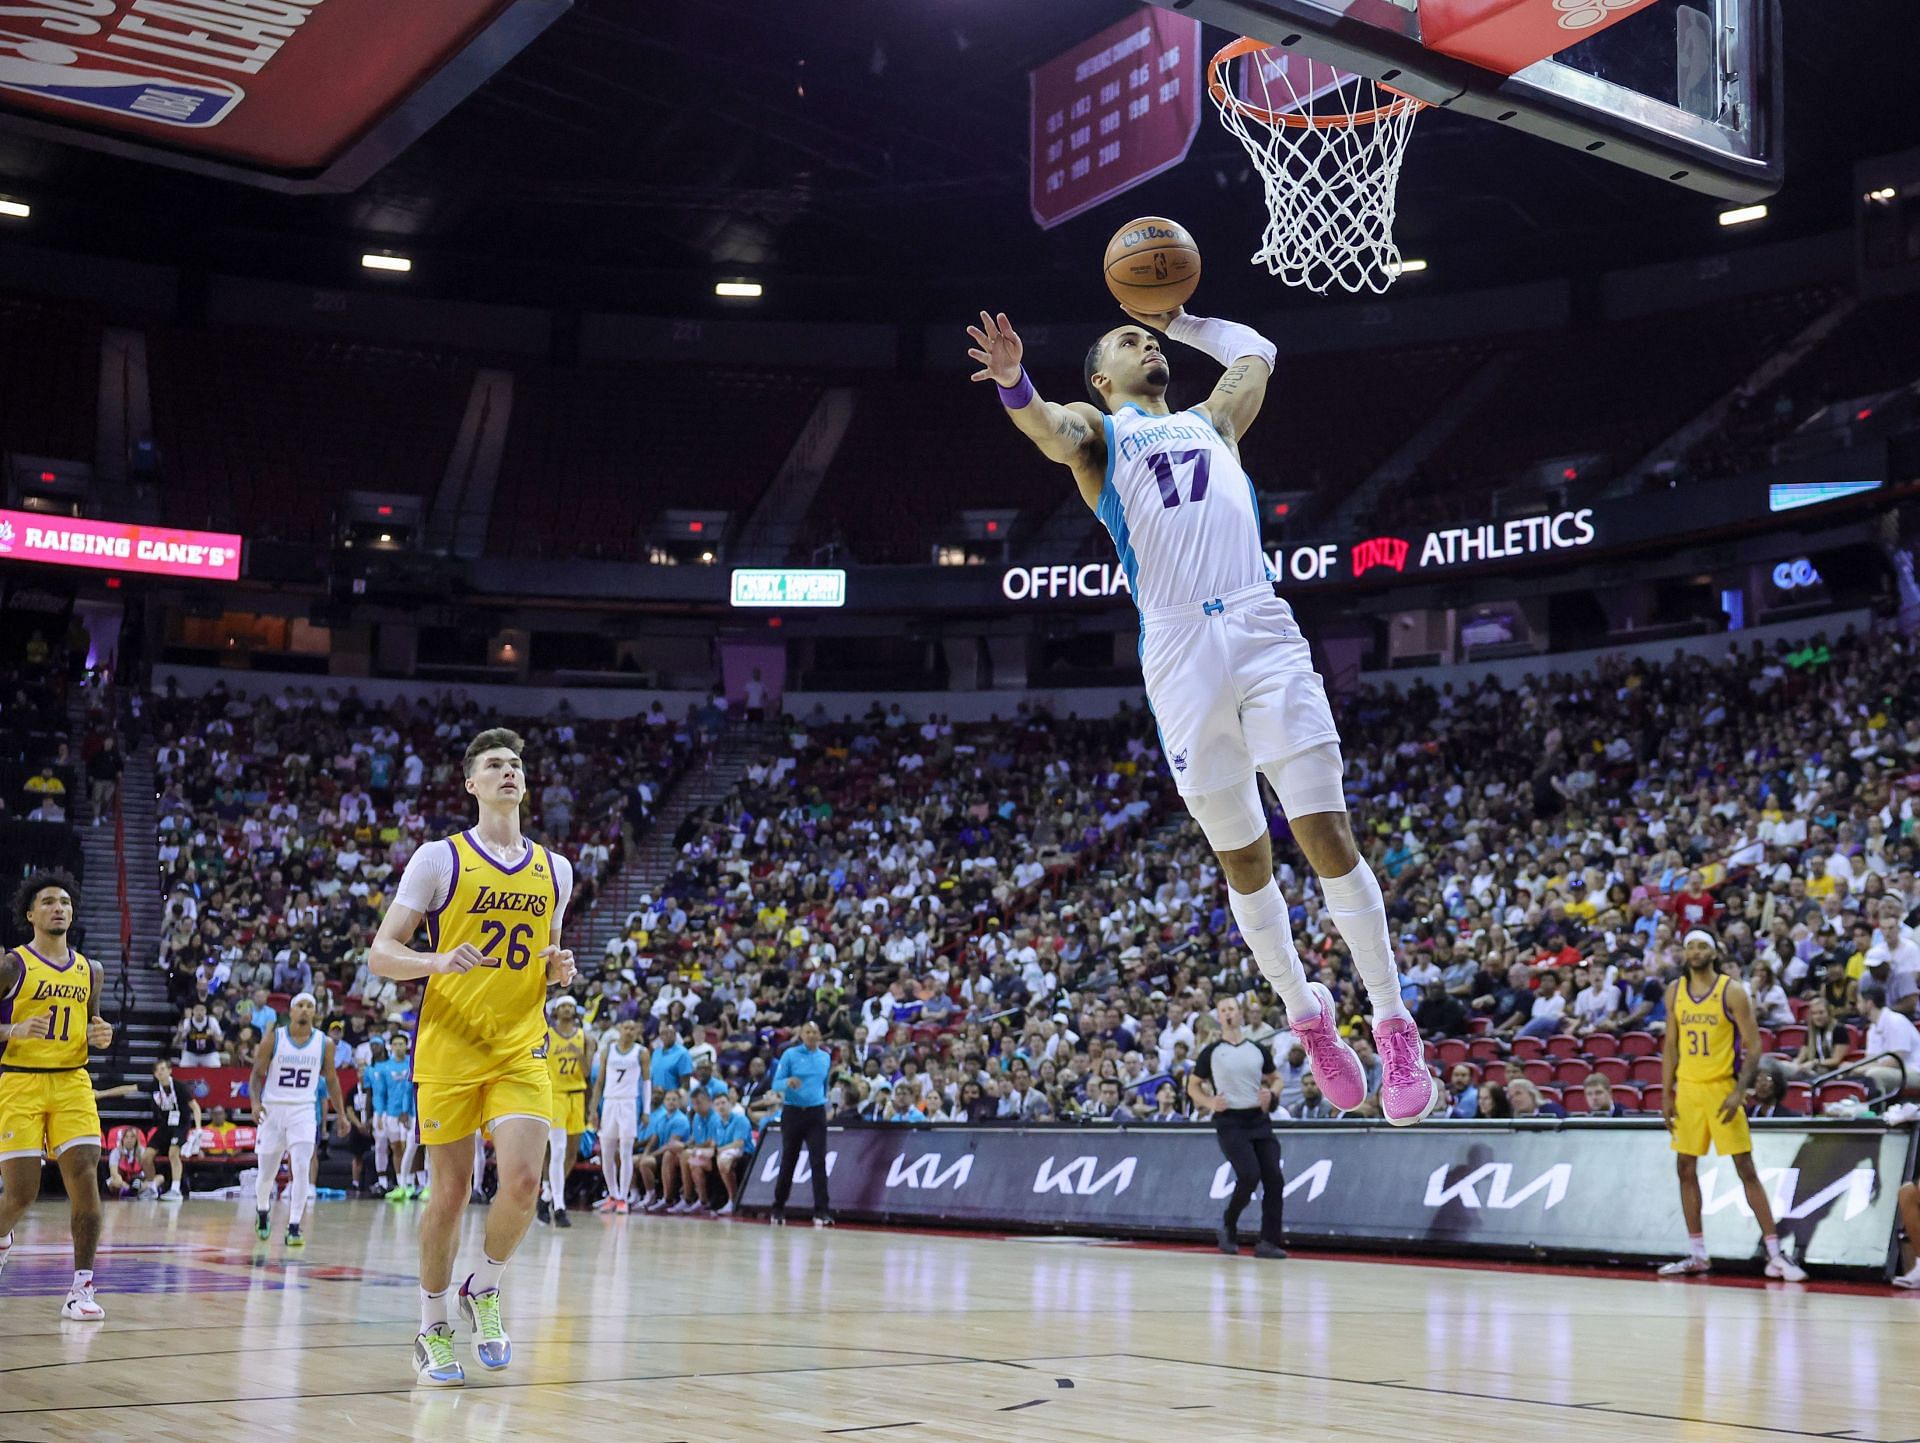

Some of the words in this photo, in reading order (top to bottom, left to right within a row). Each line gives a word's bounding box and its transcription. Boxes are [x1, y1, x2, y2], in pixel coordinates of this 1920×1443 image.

[129, 87, 205, 121] NBA
[1122, 225, 1185, 248] Wilson
[1145, 448, 1212, 510] 17
[24, 527, 131, 559] RAISING
[1002, 563, 1133, 600] OFFICIA
[1290, 544, 1338, 581] OF
[1351, 537, 1410, 578] UNLV
[1419, 508, 1595, 567] ATHLETICS
[466, 886, 548, 917] LAKERS
[480, 919, 534, 971] 26
[32, 979, 88, 1003] LAKERS
[44, 1004, 71, 1041] 11
[1687, 1030, 1710, 1056] 31
[278, 1067, 312, 1088] 26
[558, 1056, 578, 1076] 27
[615, 1068, 627, 1084] 7
[885, 1152, 975, 1190] KIA
[1032, 1155, 1138, 1197] KIA
[1423, 1162, 1573, 1211] KIA
